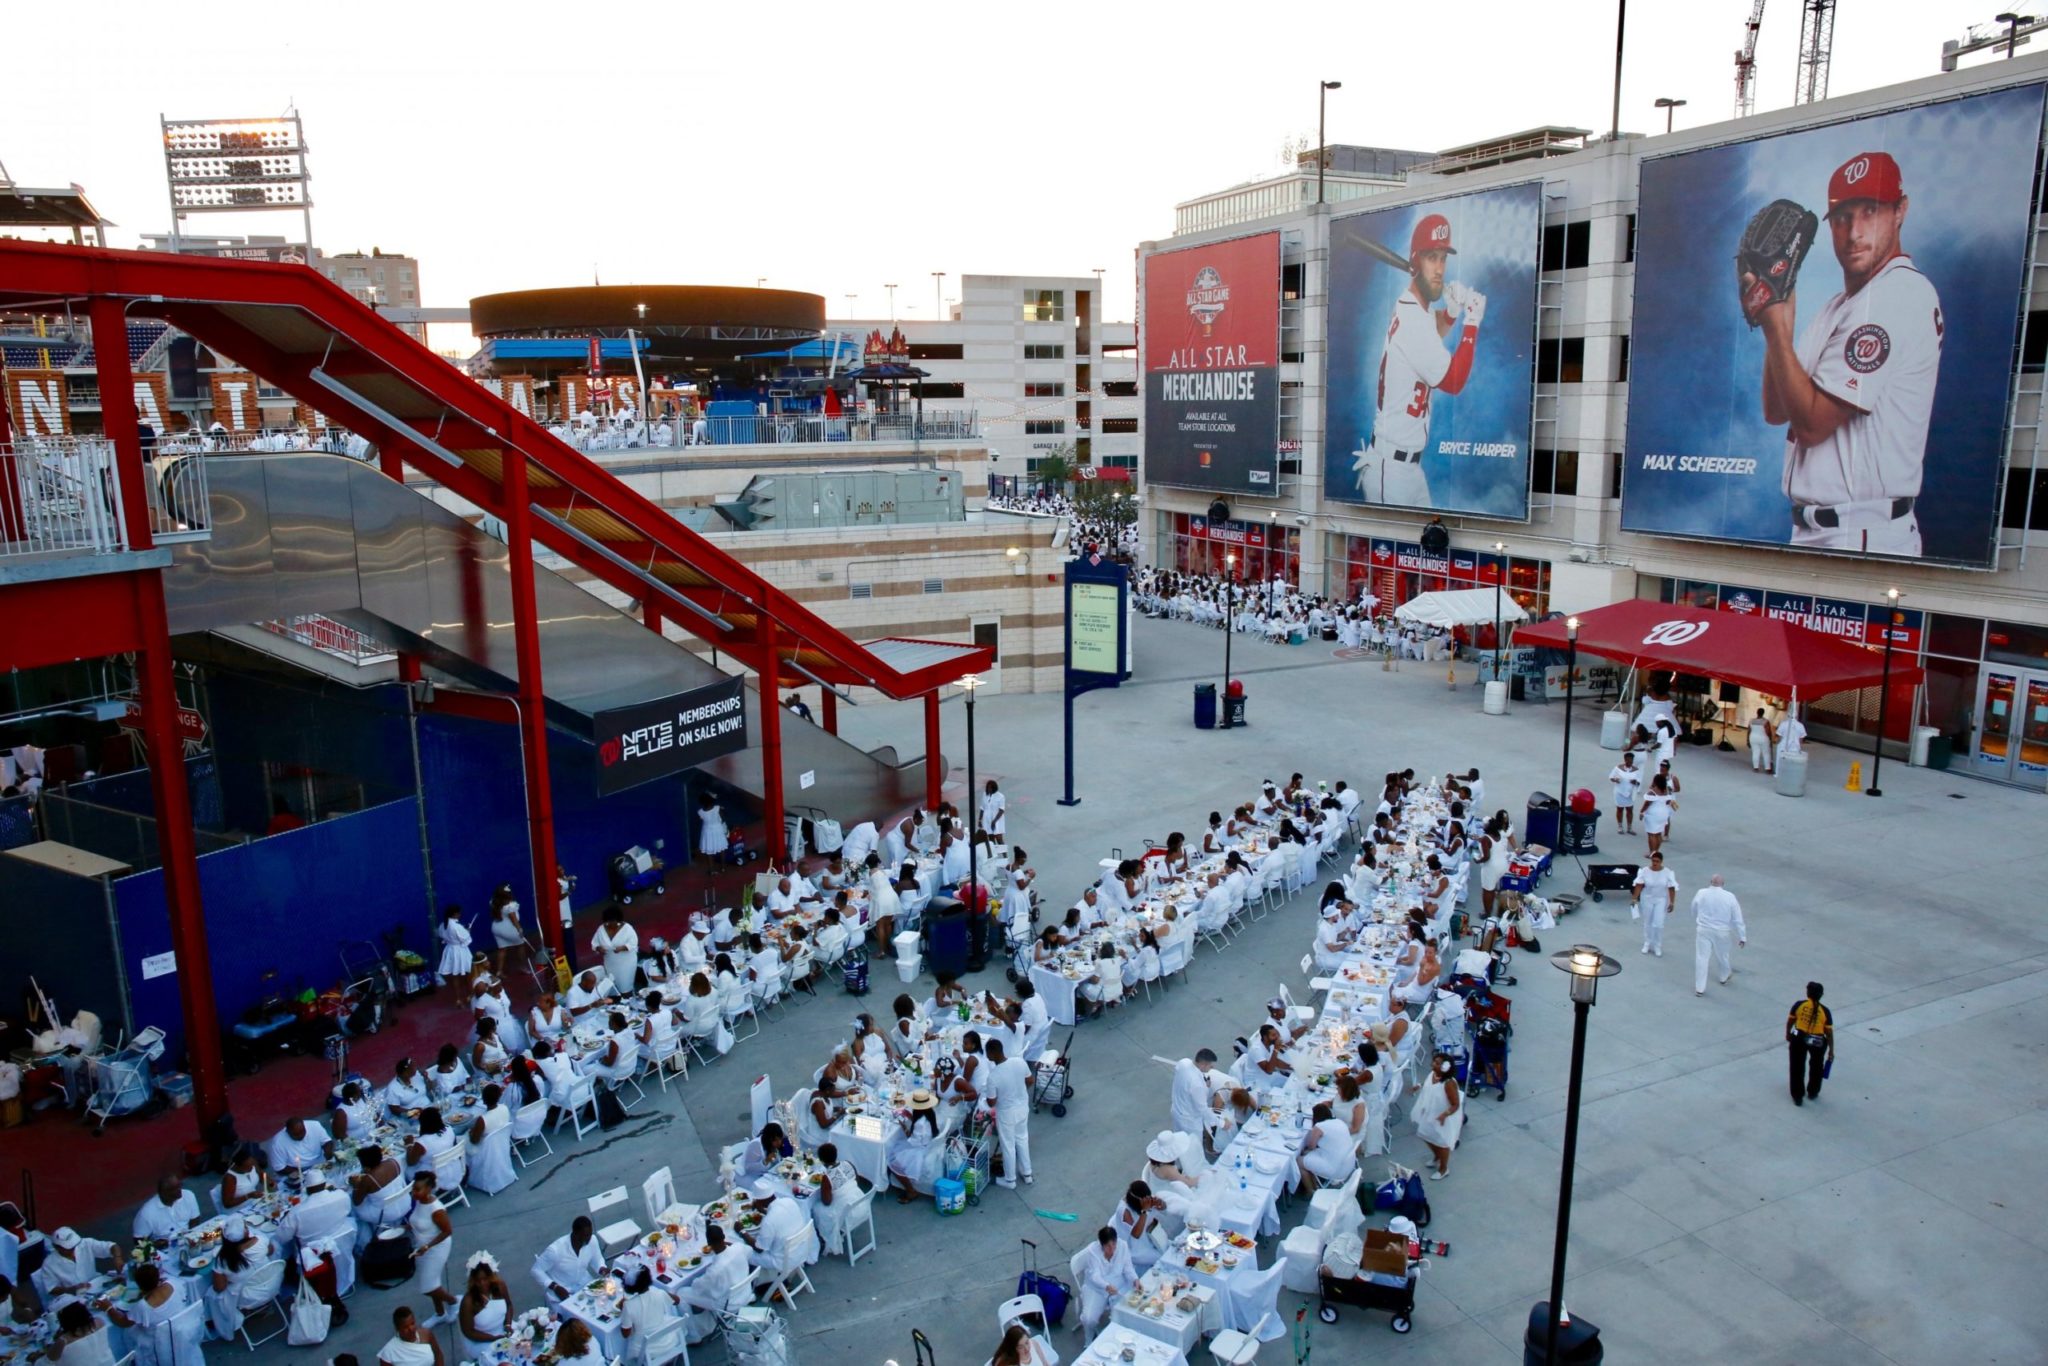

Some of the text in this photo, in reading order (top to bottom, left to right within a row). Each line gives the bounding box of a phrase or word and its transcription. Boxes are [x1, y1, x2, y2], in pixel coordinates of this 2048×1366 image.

[1852, 327, 1889, 350] WASHINGTON
[1169, 345, 1247, 369] ALL STAR
[1847, 351, 1881, 371] NATIONALS
[1163, 371, 1255, 401] MERCHANDISE
[1186, 412, 1227, 421] AVAILABLE AT ALL
[1178, 422, 1236, 433] TEAM STORE LOCATIONS
[1438, 441, 1516, 458] BRYCE HARPER
[1642, 454, 1757, 475] MAX SCHERZER
[1209, 528, 1245, 543] MERCHANDISE
[1405, 548, 1419, 556] ALL
[1398, 555, 1448, 573] MERCHANDISE
[1783, 600, 1847, 617] ALL STAR
[1518, 652, 1536, 661] COO
[678, 696, 741, 726] MEMBERSHIPS
[622, 721, 673, 747] NATS
[678, 715, 743, 747] ON SALE NOW!
[623, 736, 673, 761] PLUS
